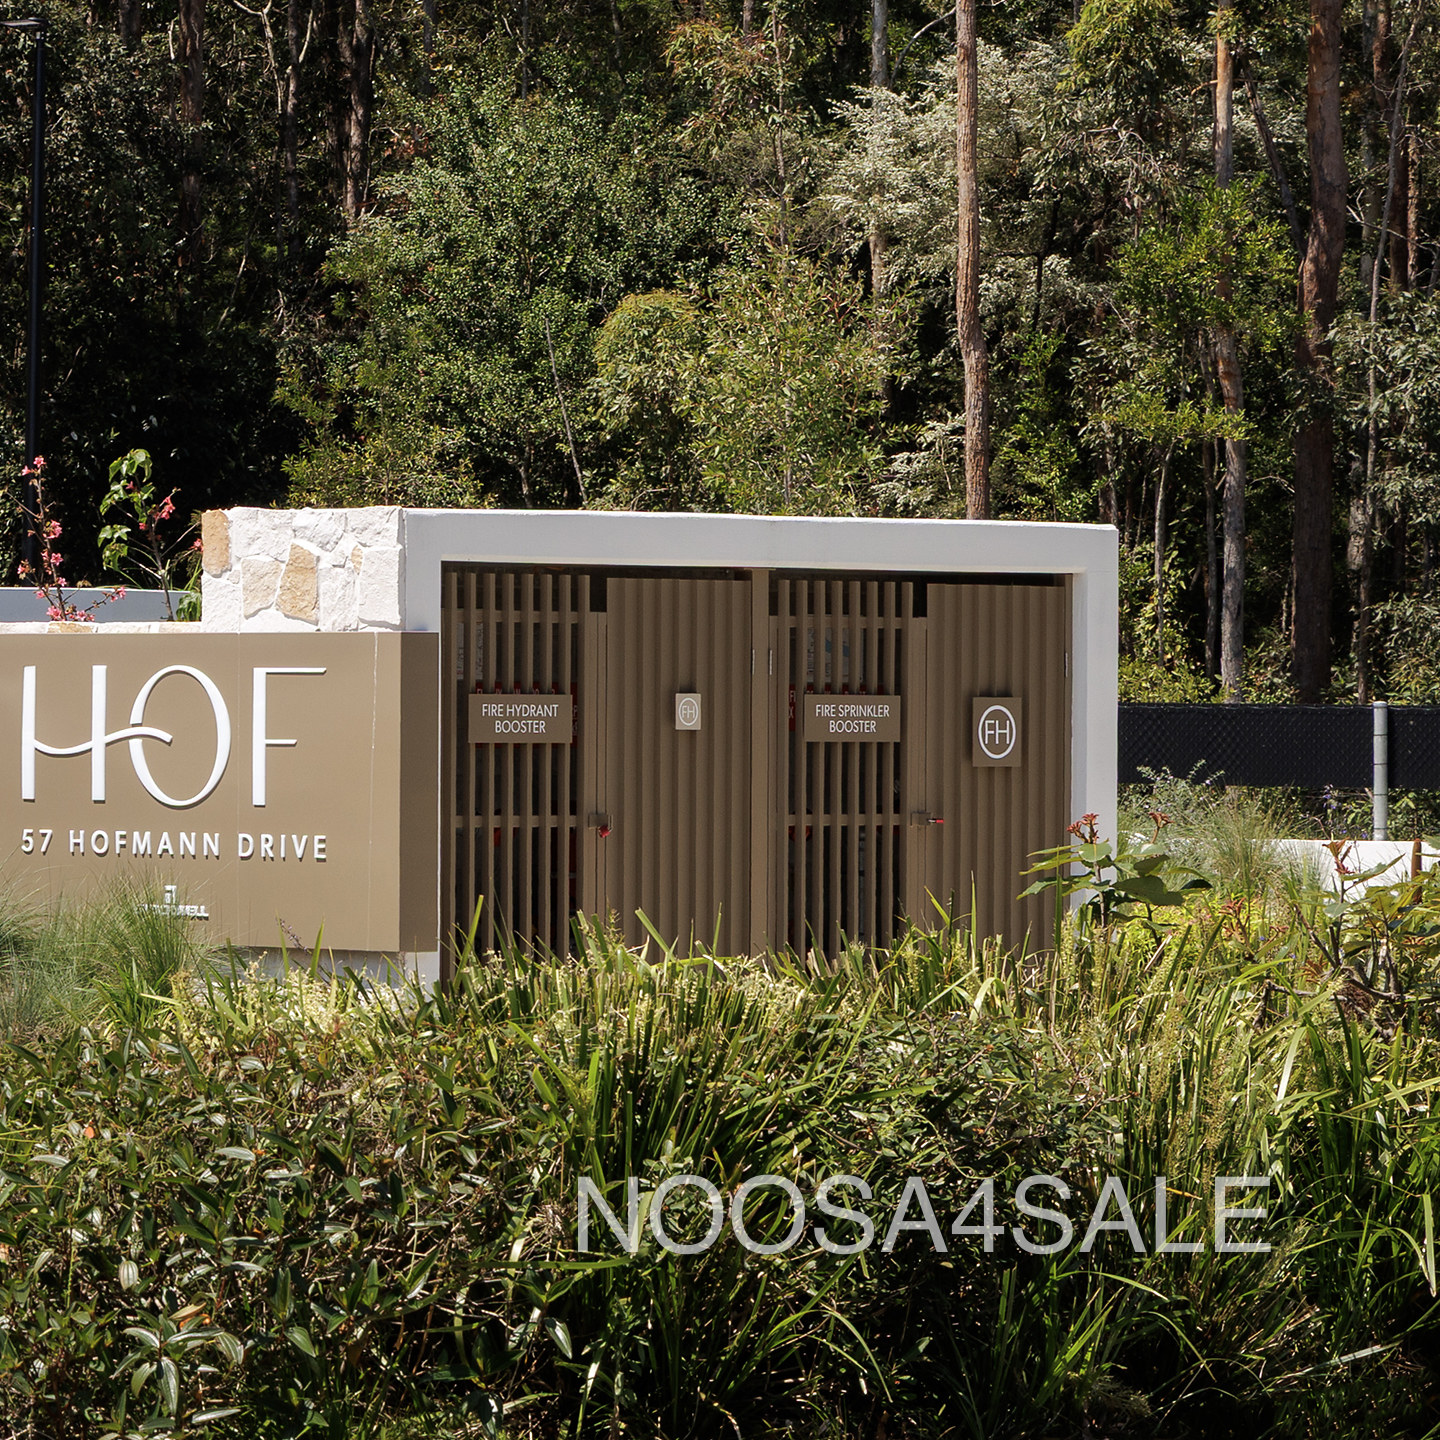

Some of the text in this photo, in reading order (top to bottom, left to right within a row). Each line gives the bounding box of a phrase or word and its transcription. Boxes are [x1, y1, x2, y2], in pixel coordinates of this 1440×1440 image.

[481, 703, 559, 717] FIRE HYDRANT
[681, 705, 696, 719] FH
[815, 704, 890, 718] FIRE SPRINKLER
[495, 720, 546, 733] BOOSTER
[829, 720, 877, 733] BOOSTER
[984, 719, 1010, 745] FH
[21, 664, 327, 807] HOF
[21, 828, 328, 860] 57 HOFMANN DRIVE
